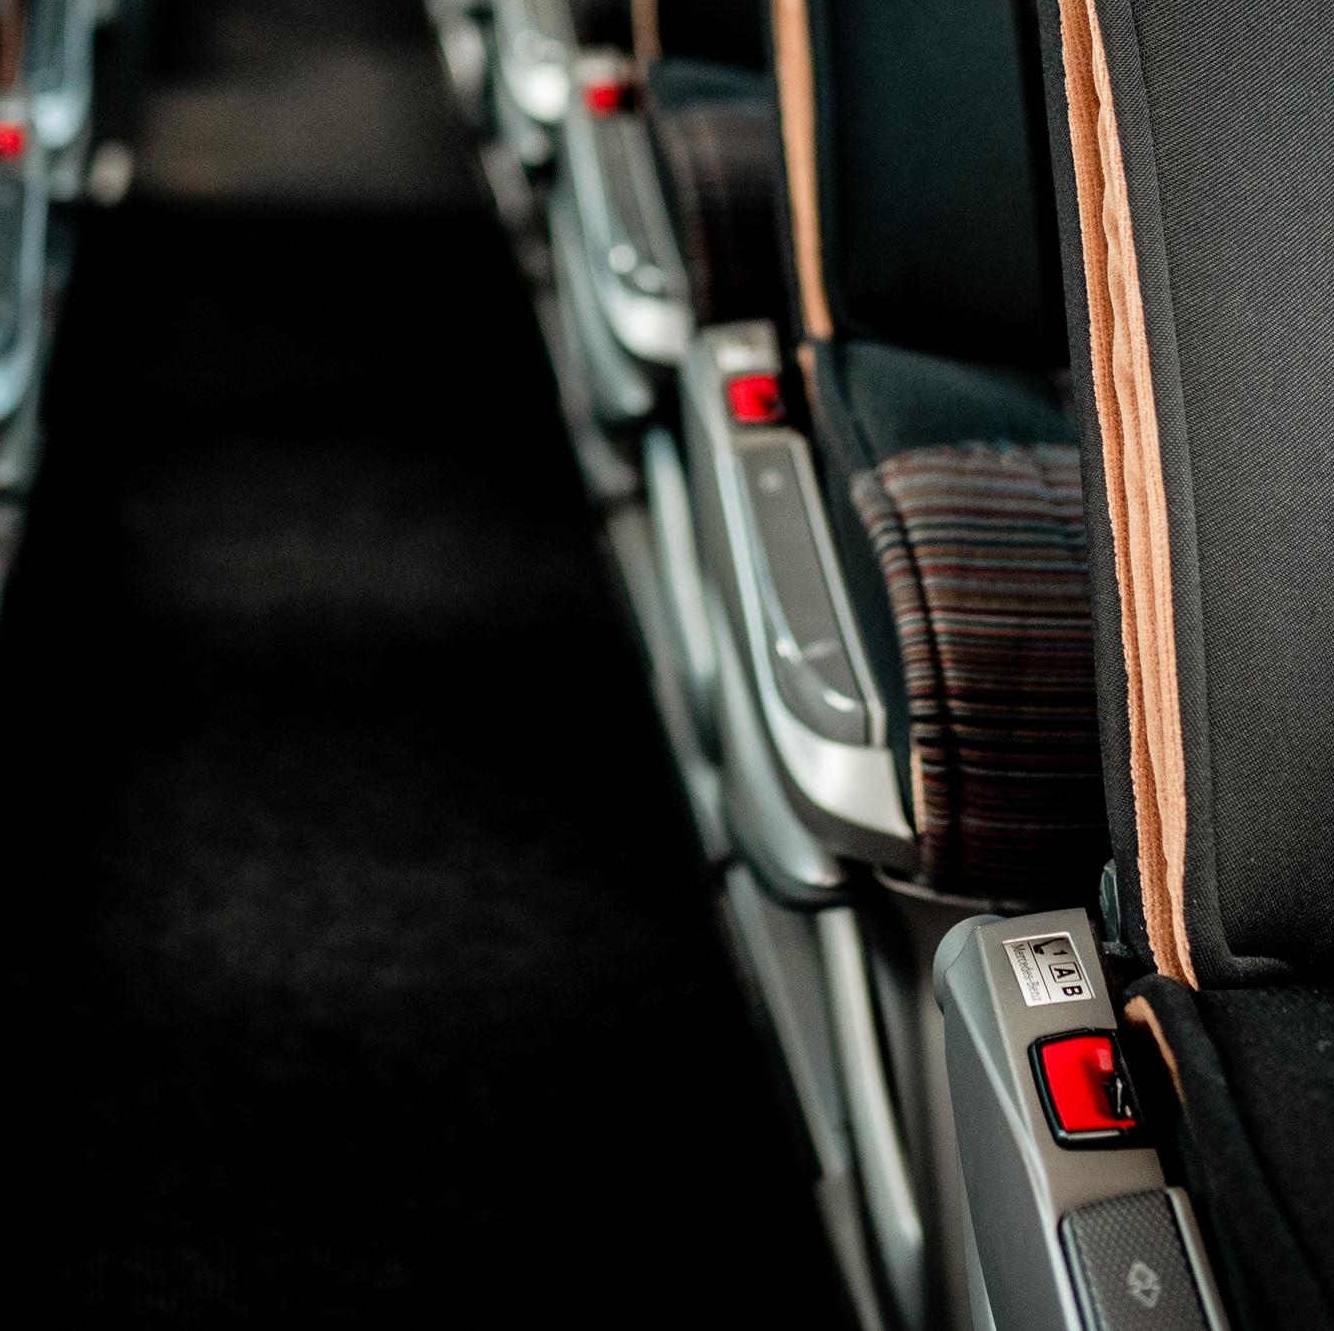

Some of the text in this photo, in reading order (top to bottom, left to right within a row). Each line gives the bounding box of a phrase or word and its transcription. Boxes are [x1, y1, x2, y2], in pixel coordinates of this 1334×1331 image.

[1011, 943, 1043, 1002] Mercedes-Benz
[1054, 967, 1076, 979] A
[1061, 985, 1084, 997] B
